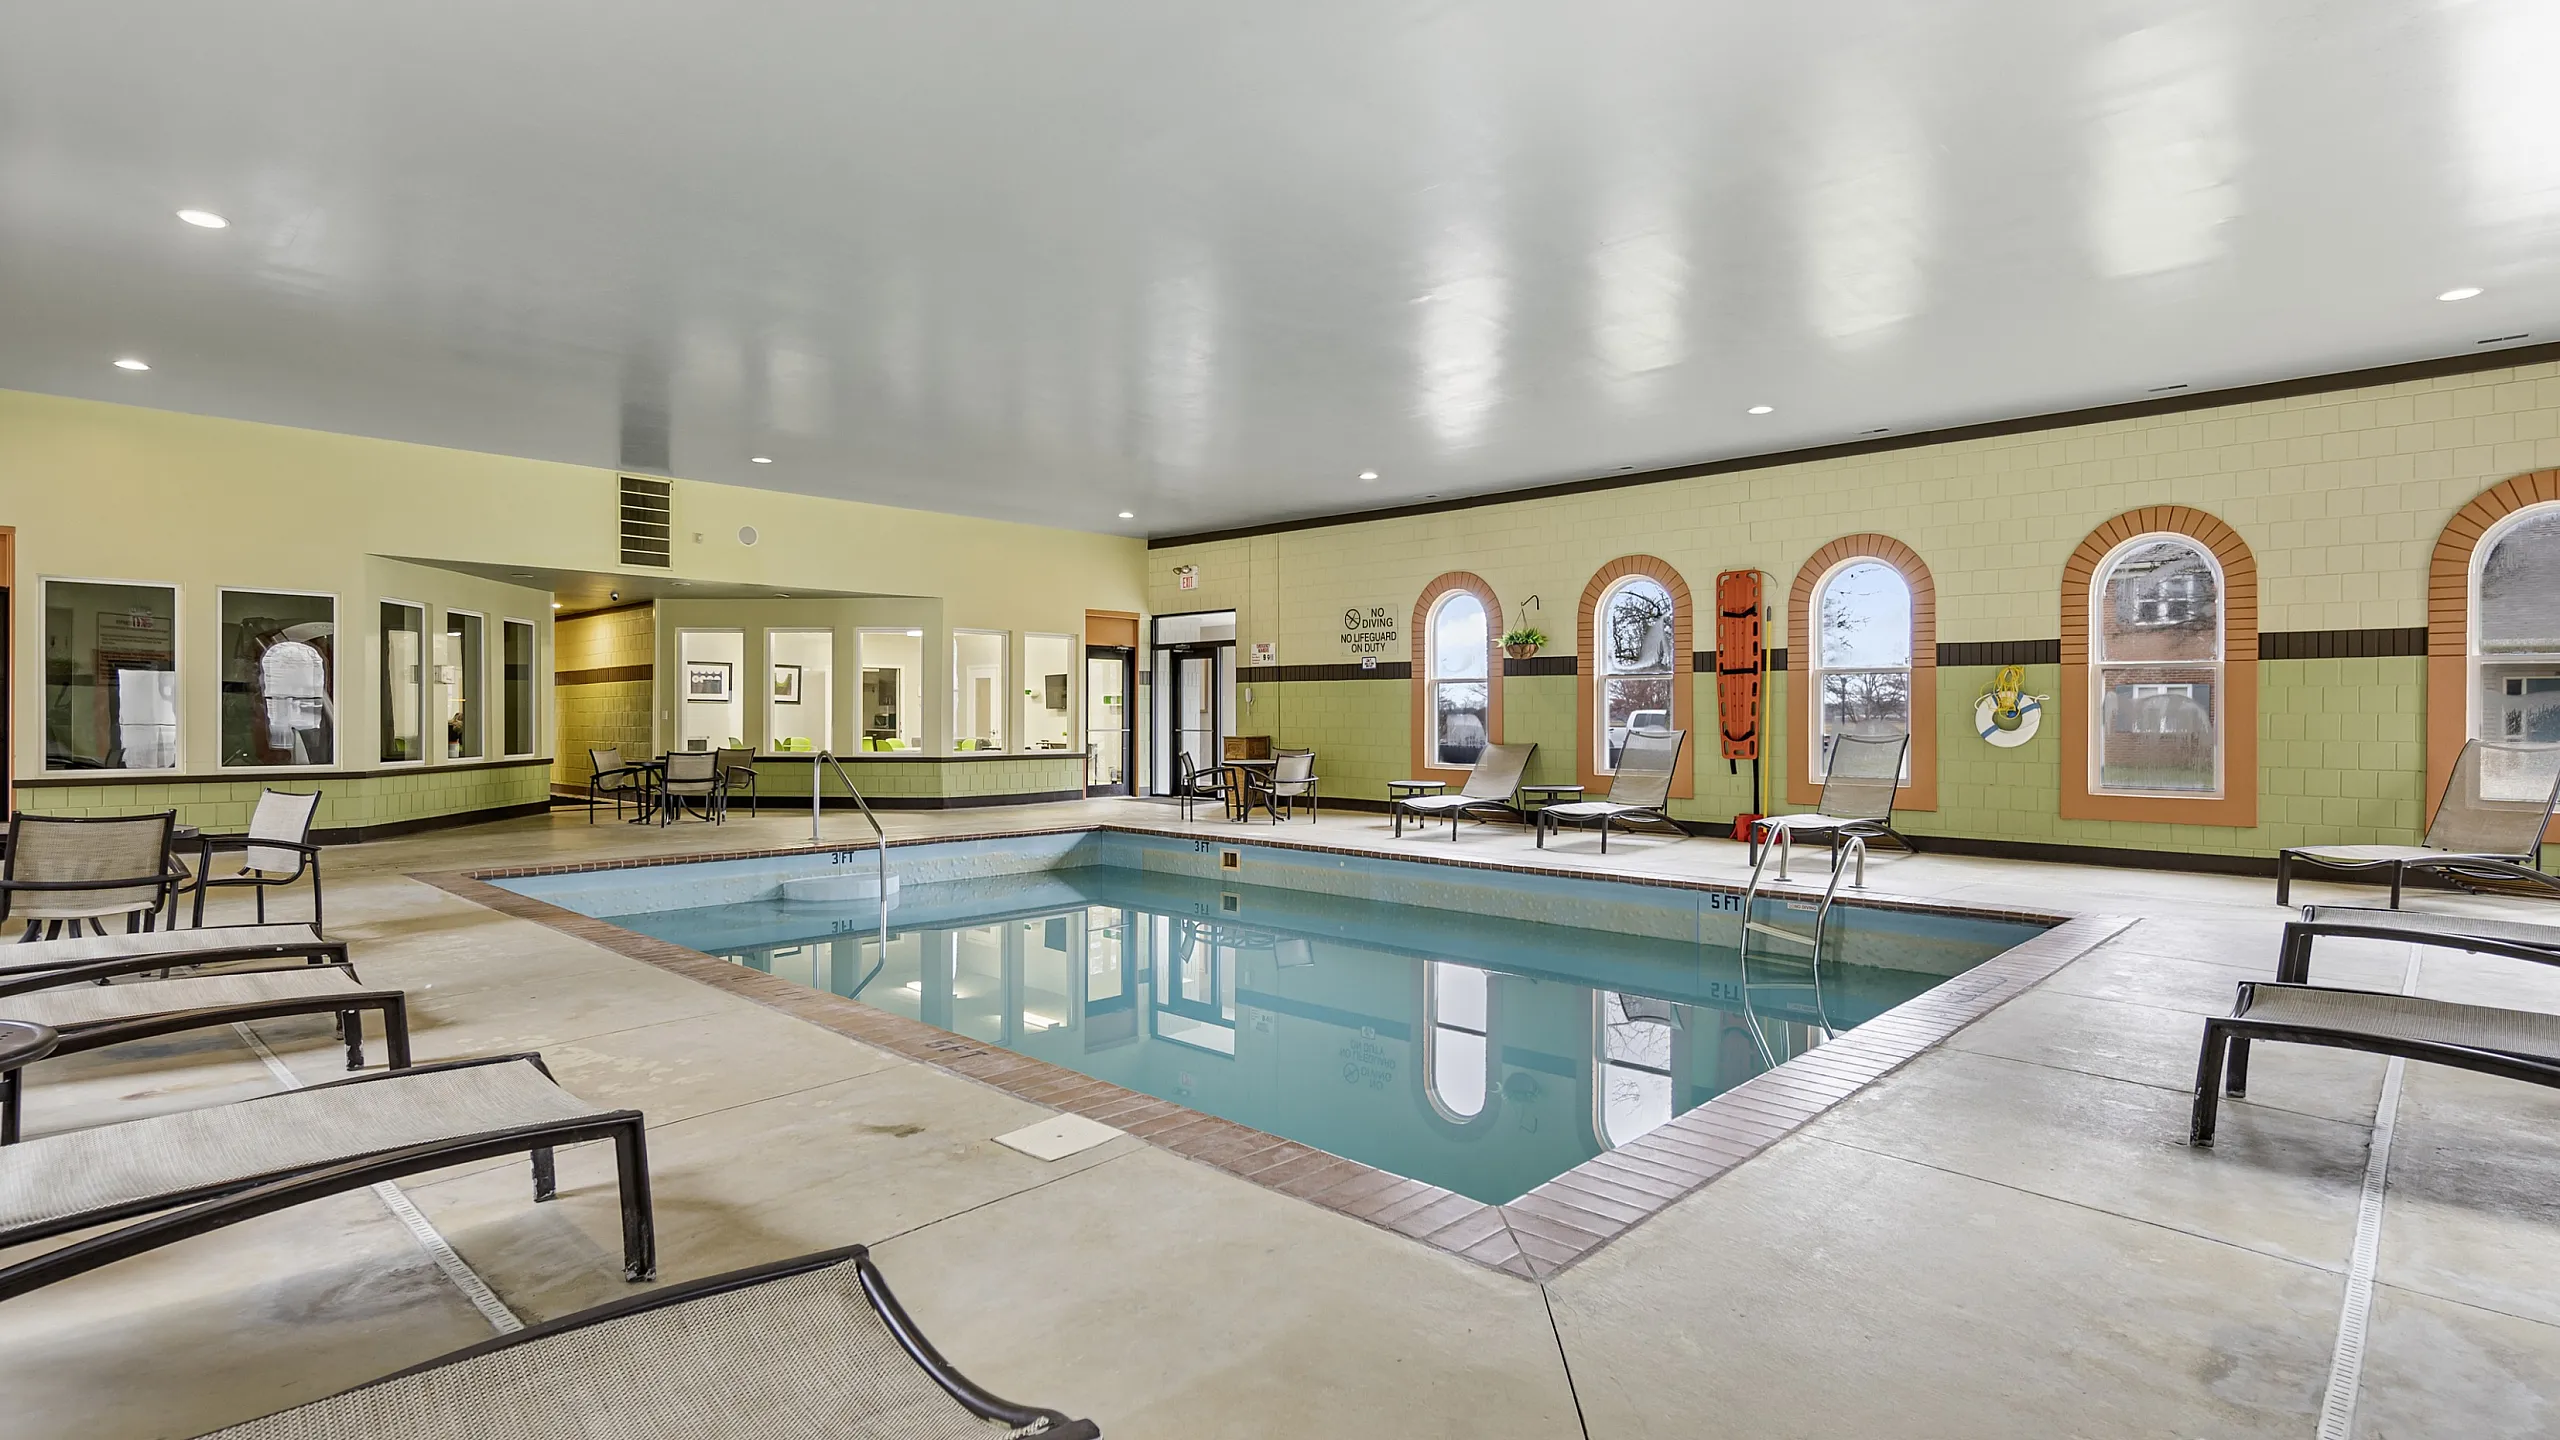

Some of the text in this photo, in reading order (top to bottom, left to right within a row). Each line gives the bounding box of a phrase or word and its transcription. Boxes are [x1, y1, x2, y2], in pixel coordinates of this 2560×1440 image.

[1182, 577, 1193, 588] EXIT
[1371, 607, 1385, 617] NO
[1362, 617, 1393, 628] DIVING
[1340, 631, 1397, 643] NO LIFEGUARD
[1351, 642, 1386, 653] ON DUTY
[1194, 841, 1209, 853] 3 FT
[831, 851, 854, 864] 3 FT
[1711, 893, 1740, 911] 5 FT
